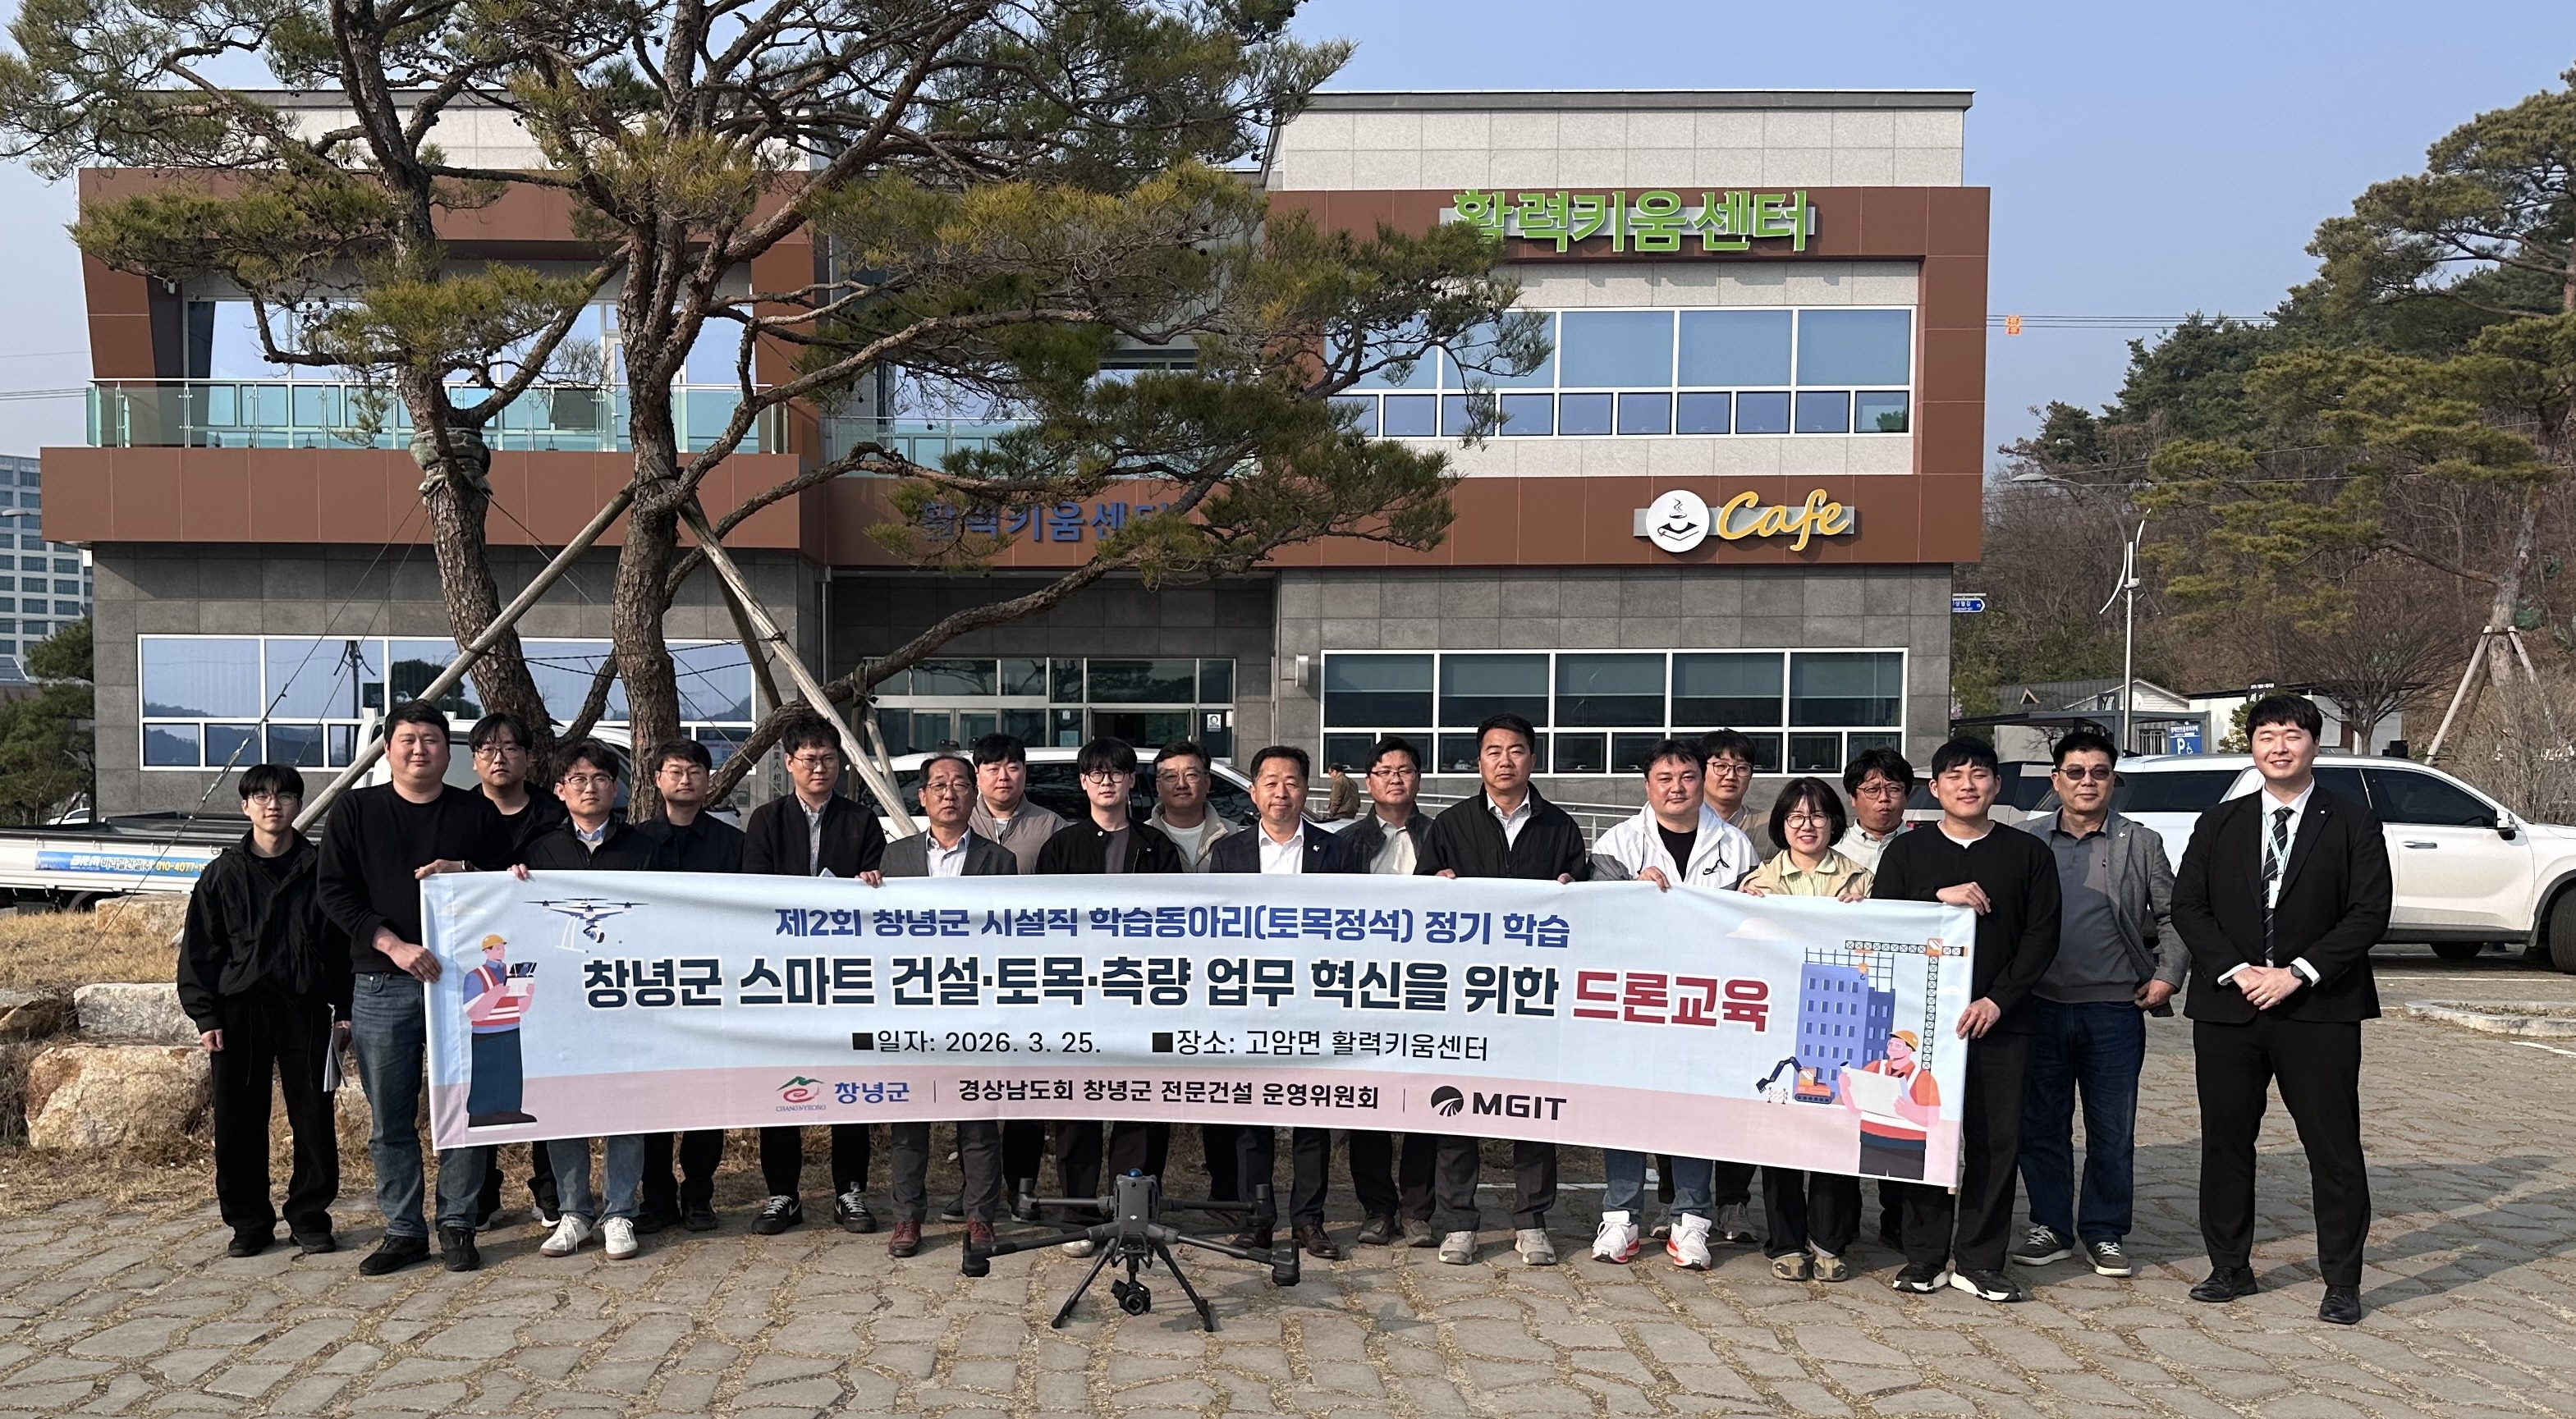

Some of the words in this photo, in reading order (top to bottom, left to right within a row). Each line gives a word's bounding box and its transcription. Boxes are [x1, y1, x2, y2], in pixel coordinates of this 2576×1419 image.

[1453, 189, 1806, 252] 활력키움센터
[1717, 489, 1849, 552] Cafe
[2177, 738, 2185, 754] P
[775, 909, 862, 936] 제2회
[873, 909, 970, 936] 창녕군
[981, 909, 1078, 936] 시설직
[1089, 905, 1413, 943] 학습동아리(토목정석)
[1425, 911, 1491, 945] 정기
[1502, 913, 1570, 948] 학습
[584, 959, 722, 1008] 창녕군
[740, 957, 875, 1005] 스마트
[892, 956, 1192, 1006] 건설·토목·측량
[1207, 958, 1295, 1007] 업무
[1311, 959, 1448, 1011] 혁신을
[1465, 965, 1560, 1017] 위한
[1573, 970, 1769, 1032] 드론교육
[945, 1032, 1018, 1053] 2026.
[1028, 1032, 1052, 1053] 3.
[1061, 1032, 1102, 1053] 25.
[1245, 1030, 1321, 1056] 고암면
[1332, 1031, 1487, 1061] 활력키움센터
[834, 1081, 910, 1104] 창녕군
[959, 1079, 1073, 1101] 경상남도회
[1083, 1079, 1152, 1101] 창녕군
[1161, 1080, 1253, 1105] 전문건설
[1262, 1083, 1379, 1109] 운영위원회
[1472, 1092, 1567, 1121] MGIT
